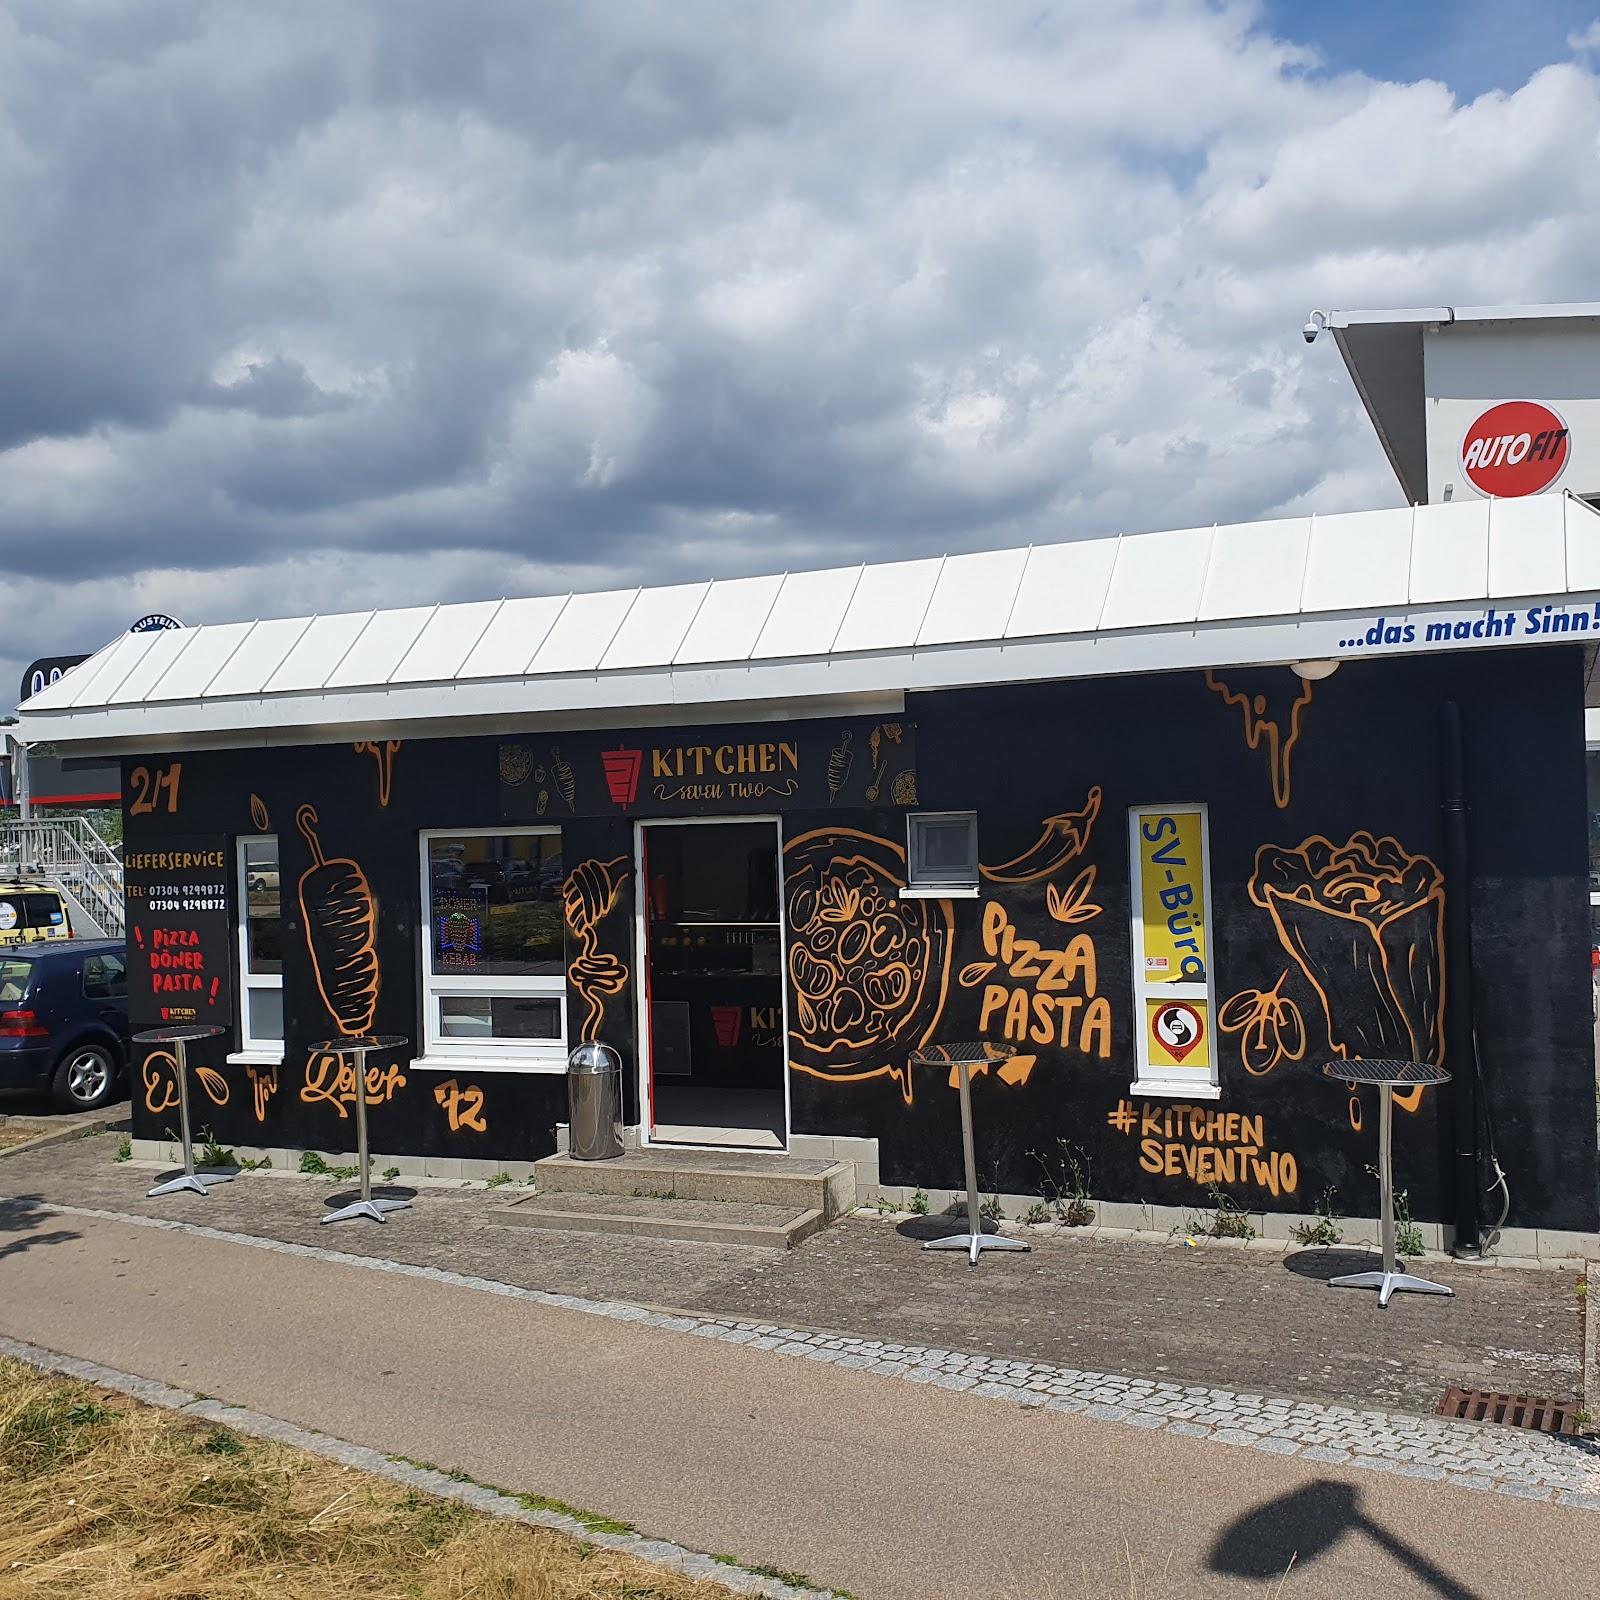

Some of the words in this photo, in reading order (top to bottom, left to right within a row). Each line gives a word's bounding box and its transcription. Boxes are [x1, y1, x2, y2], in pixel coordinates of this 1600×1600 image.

[1425, 609, 1516, 642] macht
[1524, 602, 1600, 635] Sinn!
[652, 741, 799, 777] KITCHEN
[126, 885, 147, 897] TEL:
[149, 885, 179, 896] 07304
[149, 900, 180, 910] 07304
[150, 950, 204, 970] DÖNER
[982, 900, 1097, 999] PIZZA
[153, 973, 204, 993] PASTA
[750, 1007, 782, 1029] KI
[979, 984, 1111, 1058] PASTA
